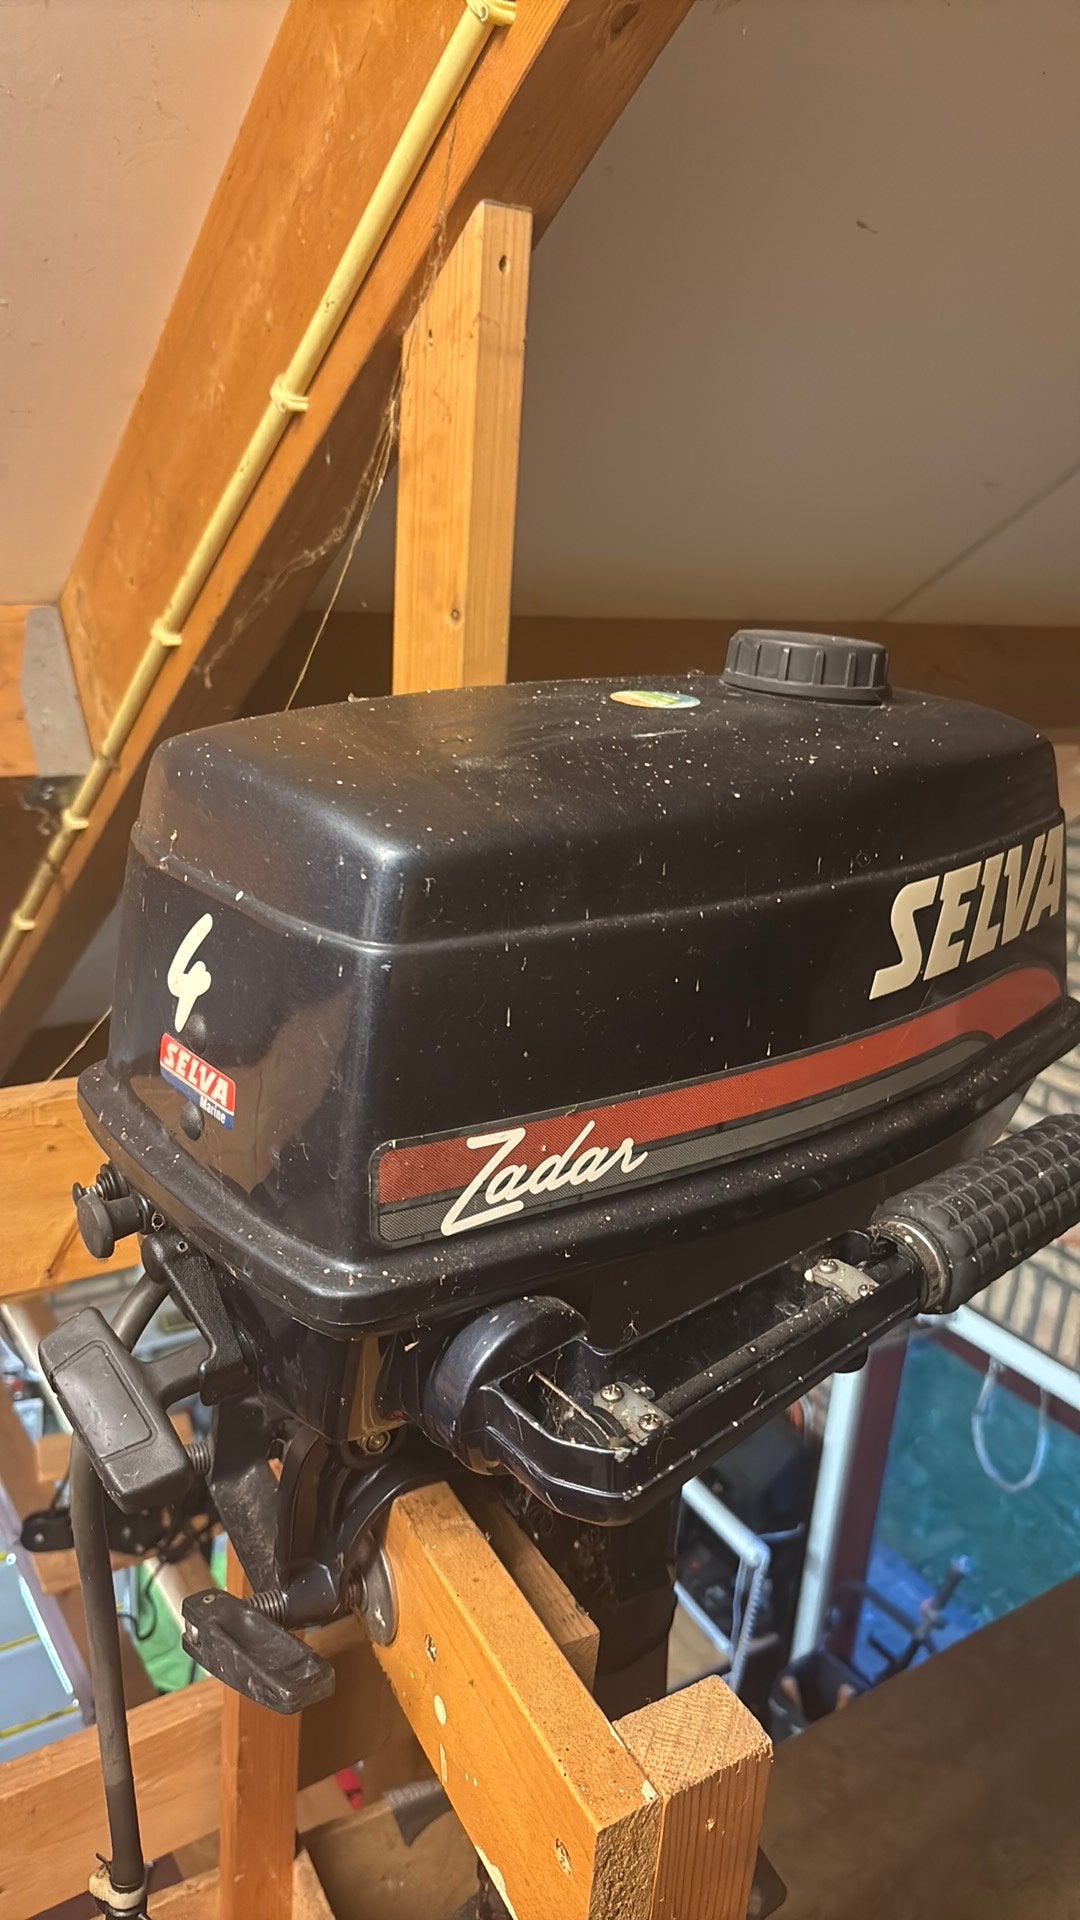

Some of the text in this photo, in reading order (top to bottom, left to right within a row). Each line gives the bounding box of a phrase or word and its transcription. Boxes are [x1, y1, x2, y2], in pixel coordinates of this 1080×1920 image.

[868, 822, 1065, 1000] SELVA
[167, 912, 214, 1033] 4
[163, 1042, 229, 1106] SELVA
[199, 1096, 226, 1125] Marine
[440, 1120, 649, 1237] Zadar
